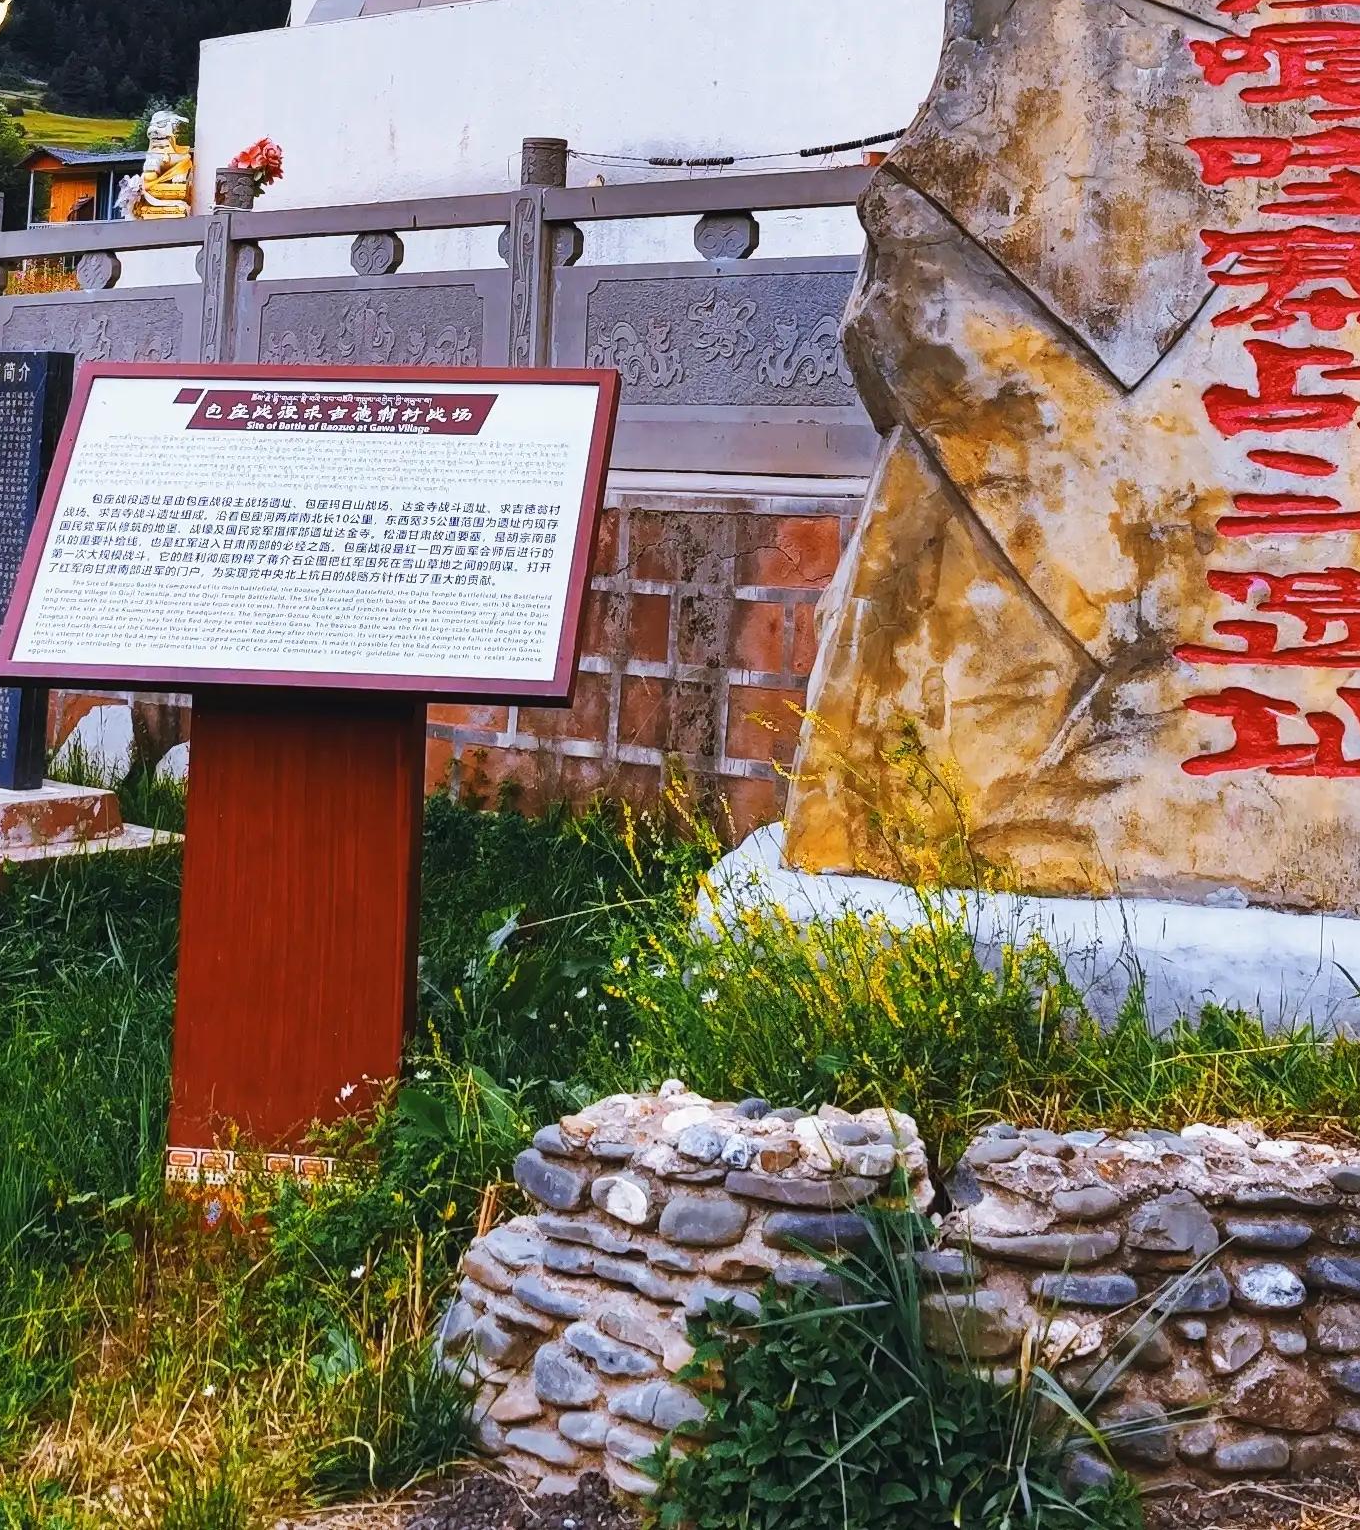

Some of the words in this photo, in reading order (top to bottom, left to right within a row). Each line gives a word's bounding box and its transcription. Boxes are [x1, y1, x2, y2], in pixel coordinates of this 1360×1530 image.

[246, 421, 265, 430] Site
[266, 421, 278, 430] of
[278, 421, 308, 431] Battle
[308, 422, 320, 431] of
[398, 424, 431, 435] Village
